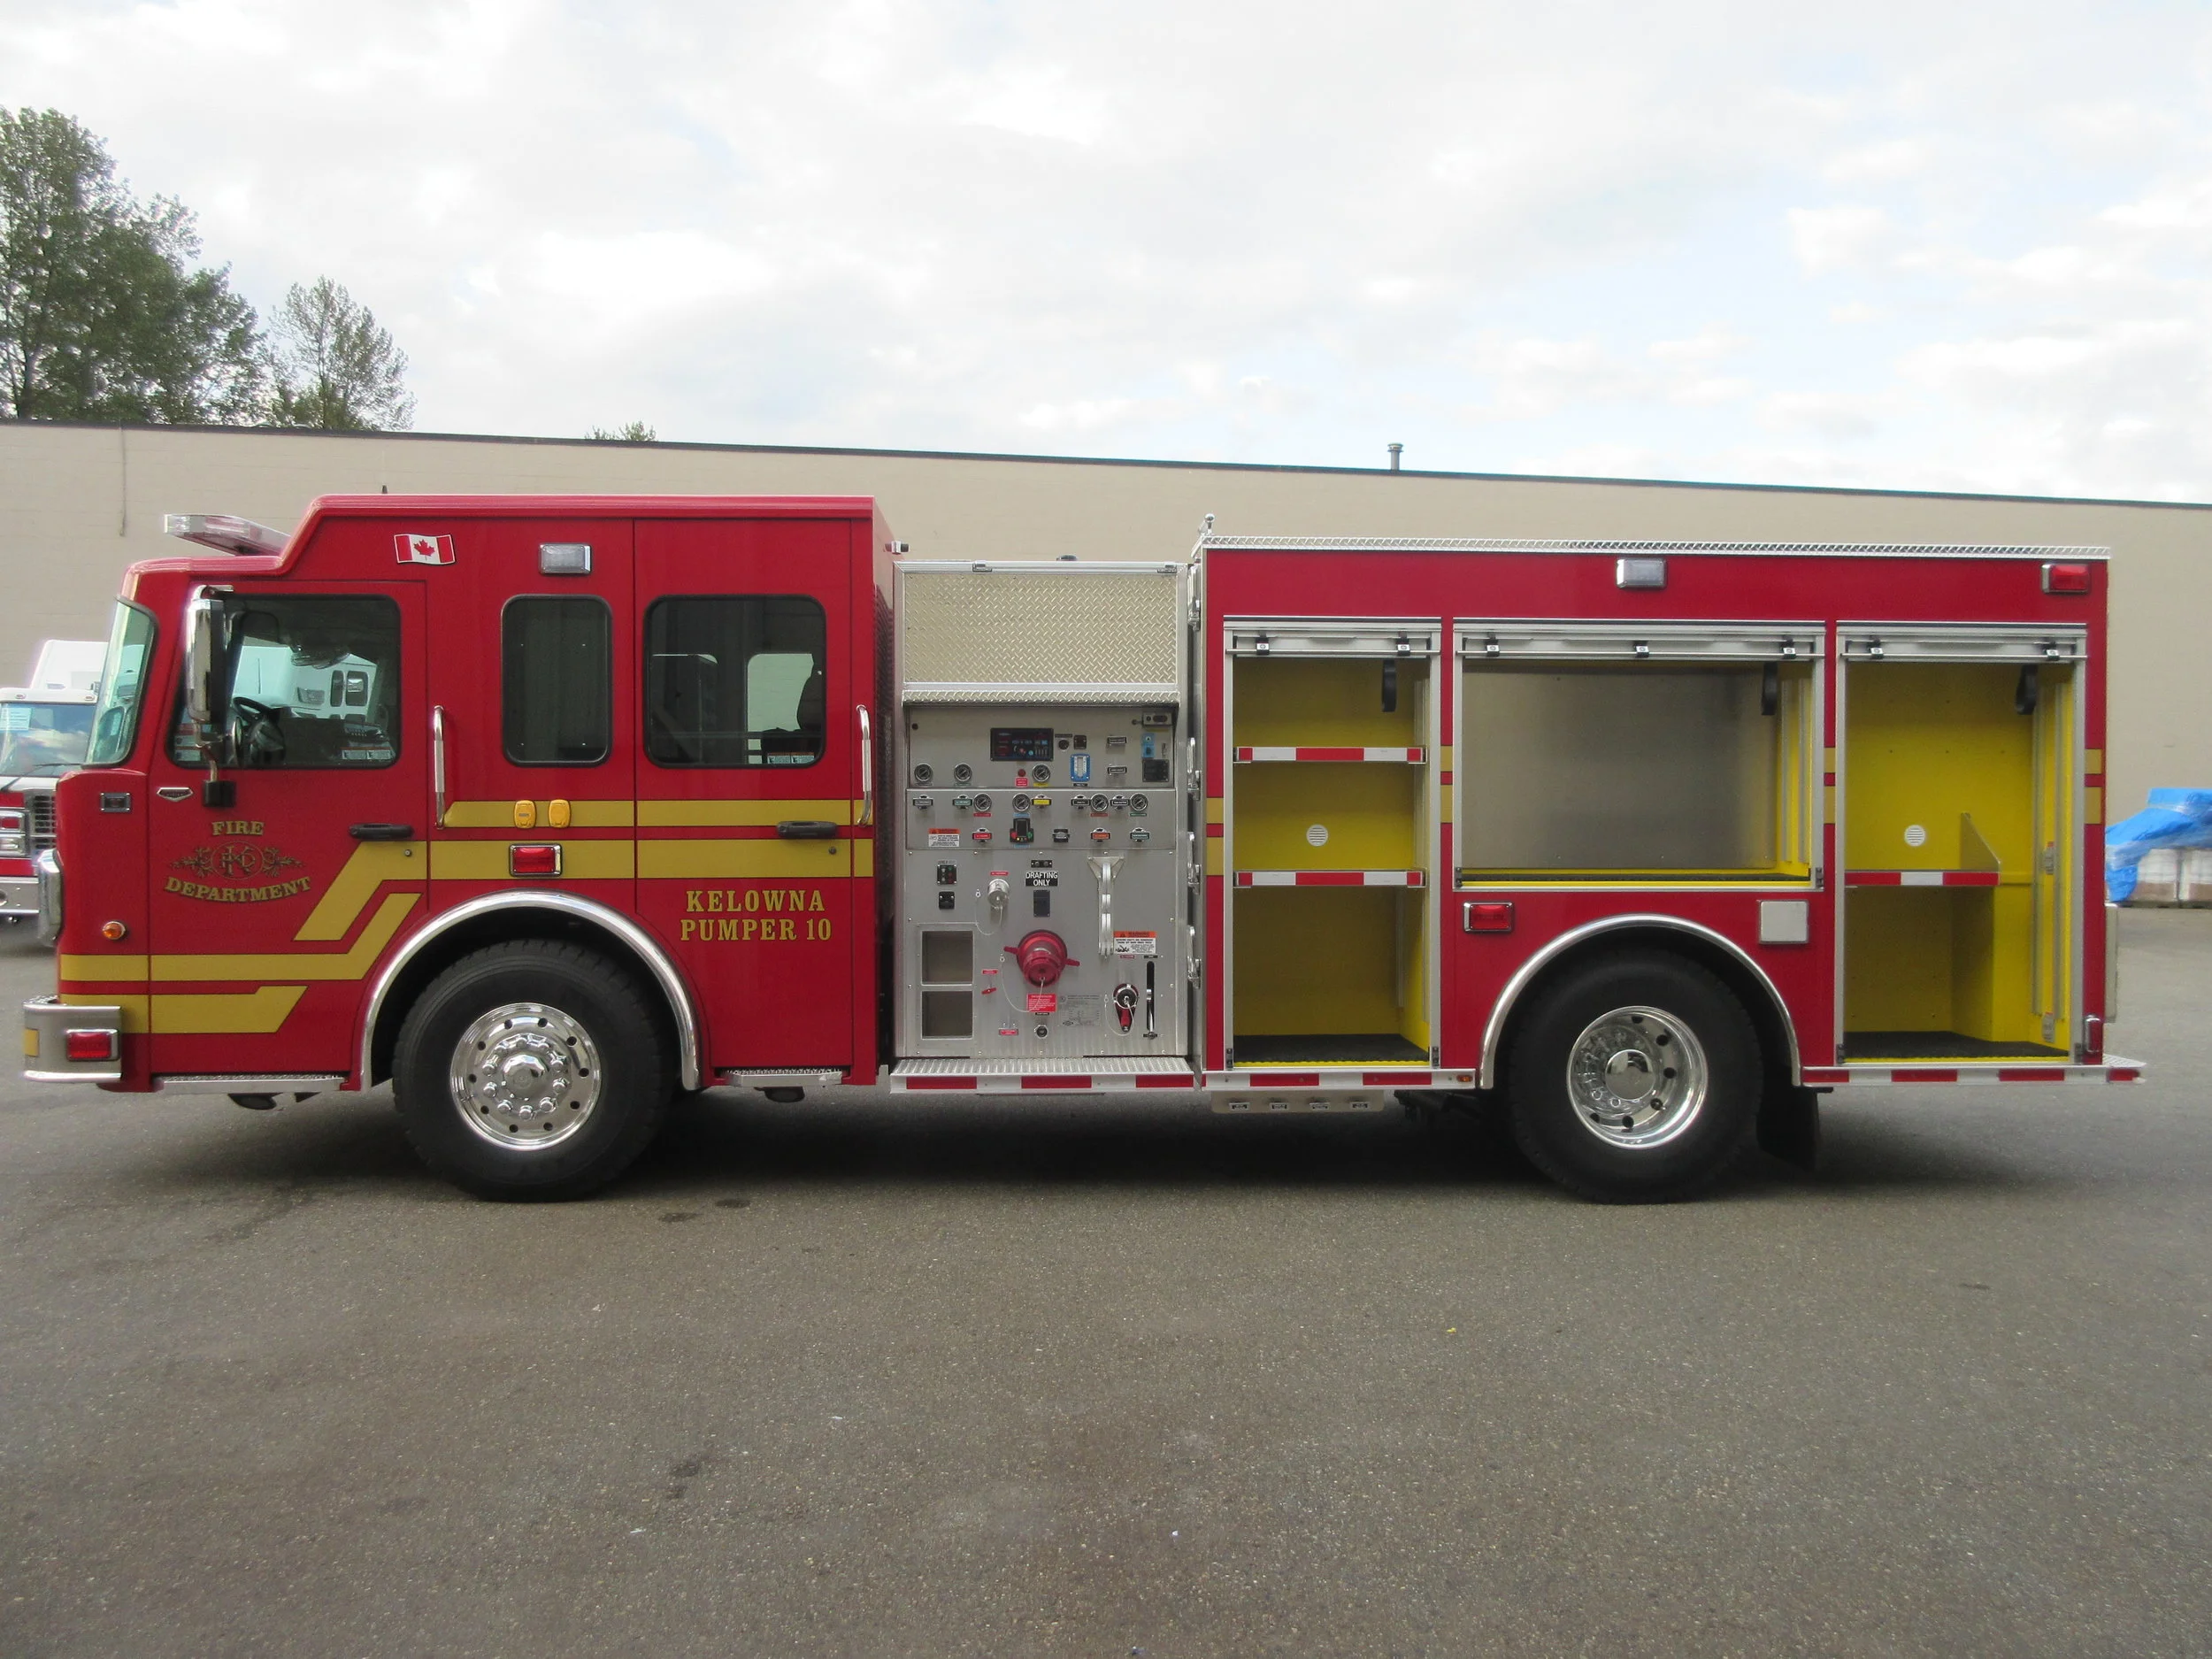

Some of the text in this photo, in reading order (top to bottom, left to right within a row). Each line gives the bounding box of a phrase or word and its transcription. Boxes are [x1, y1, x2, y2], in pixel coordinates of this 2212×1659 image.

[211, 820, 265, 835] FIRE
[165, 876, 311, 902] DEPARTMENT
[687, 890, 826, 912] KELOWNA
[680, 918, 832, 941] PUMPER 10
